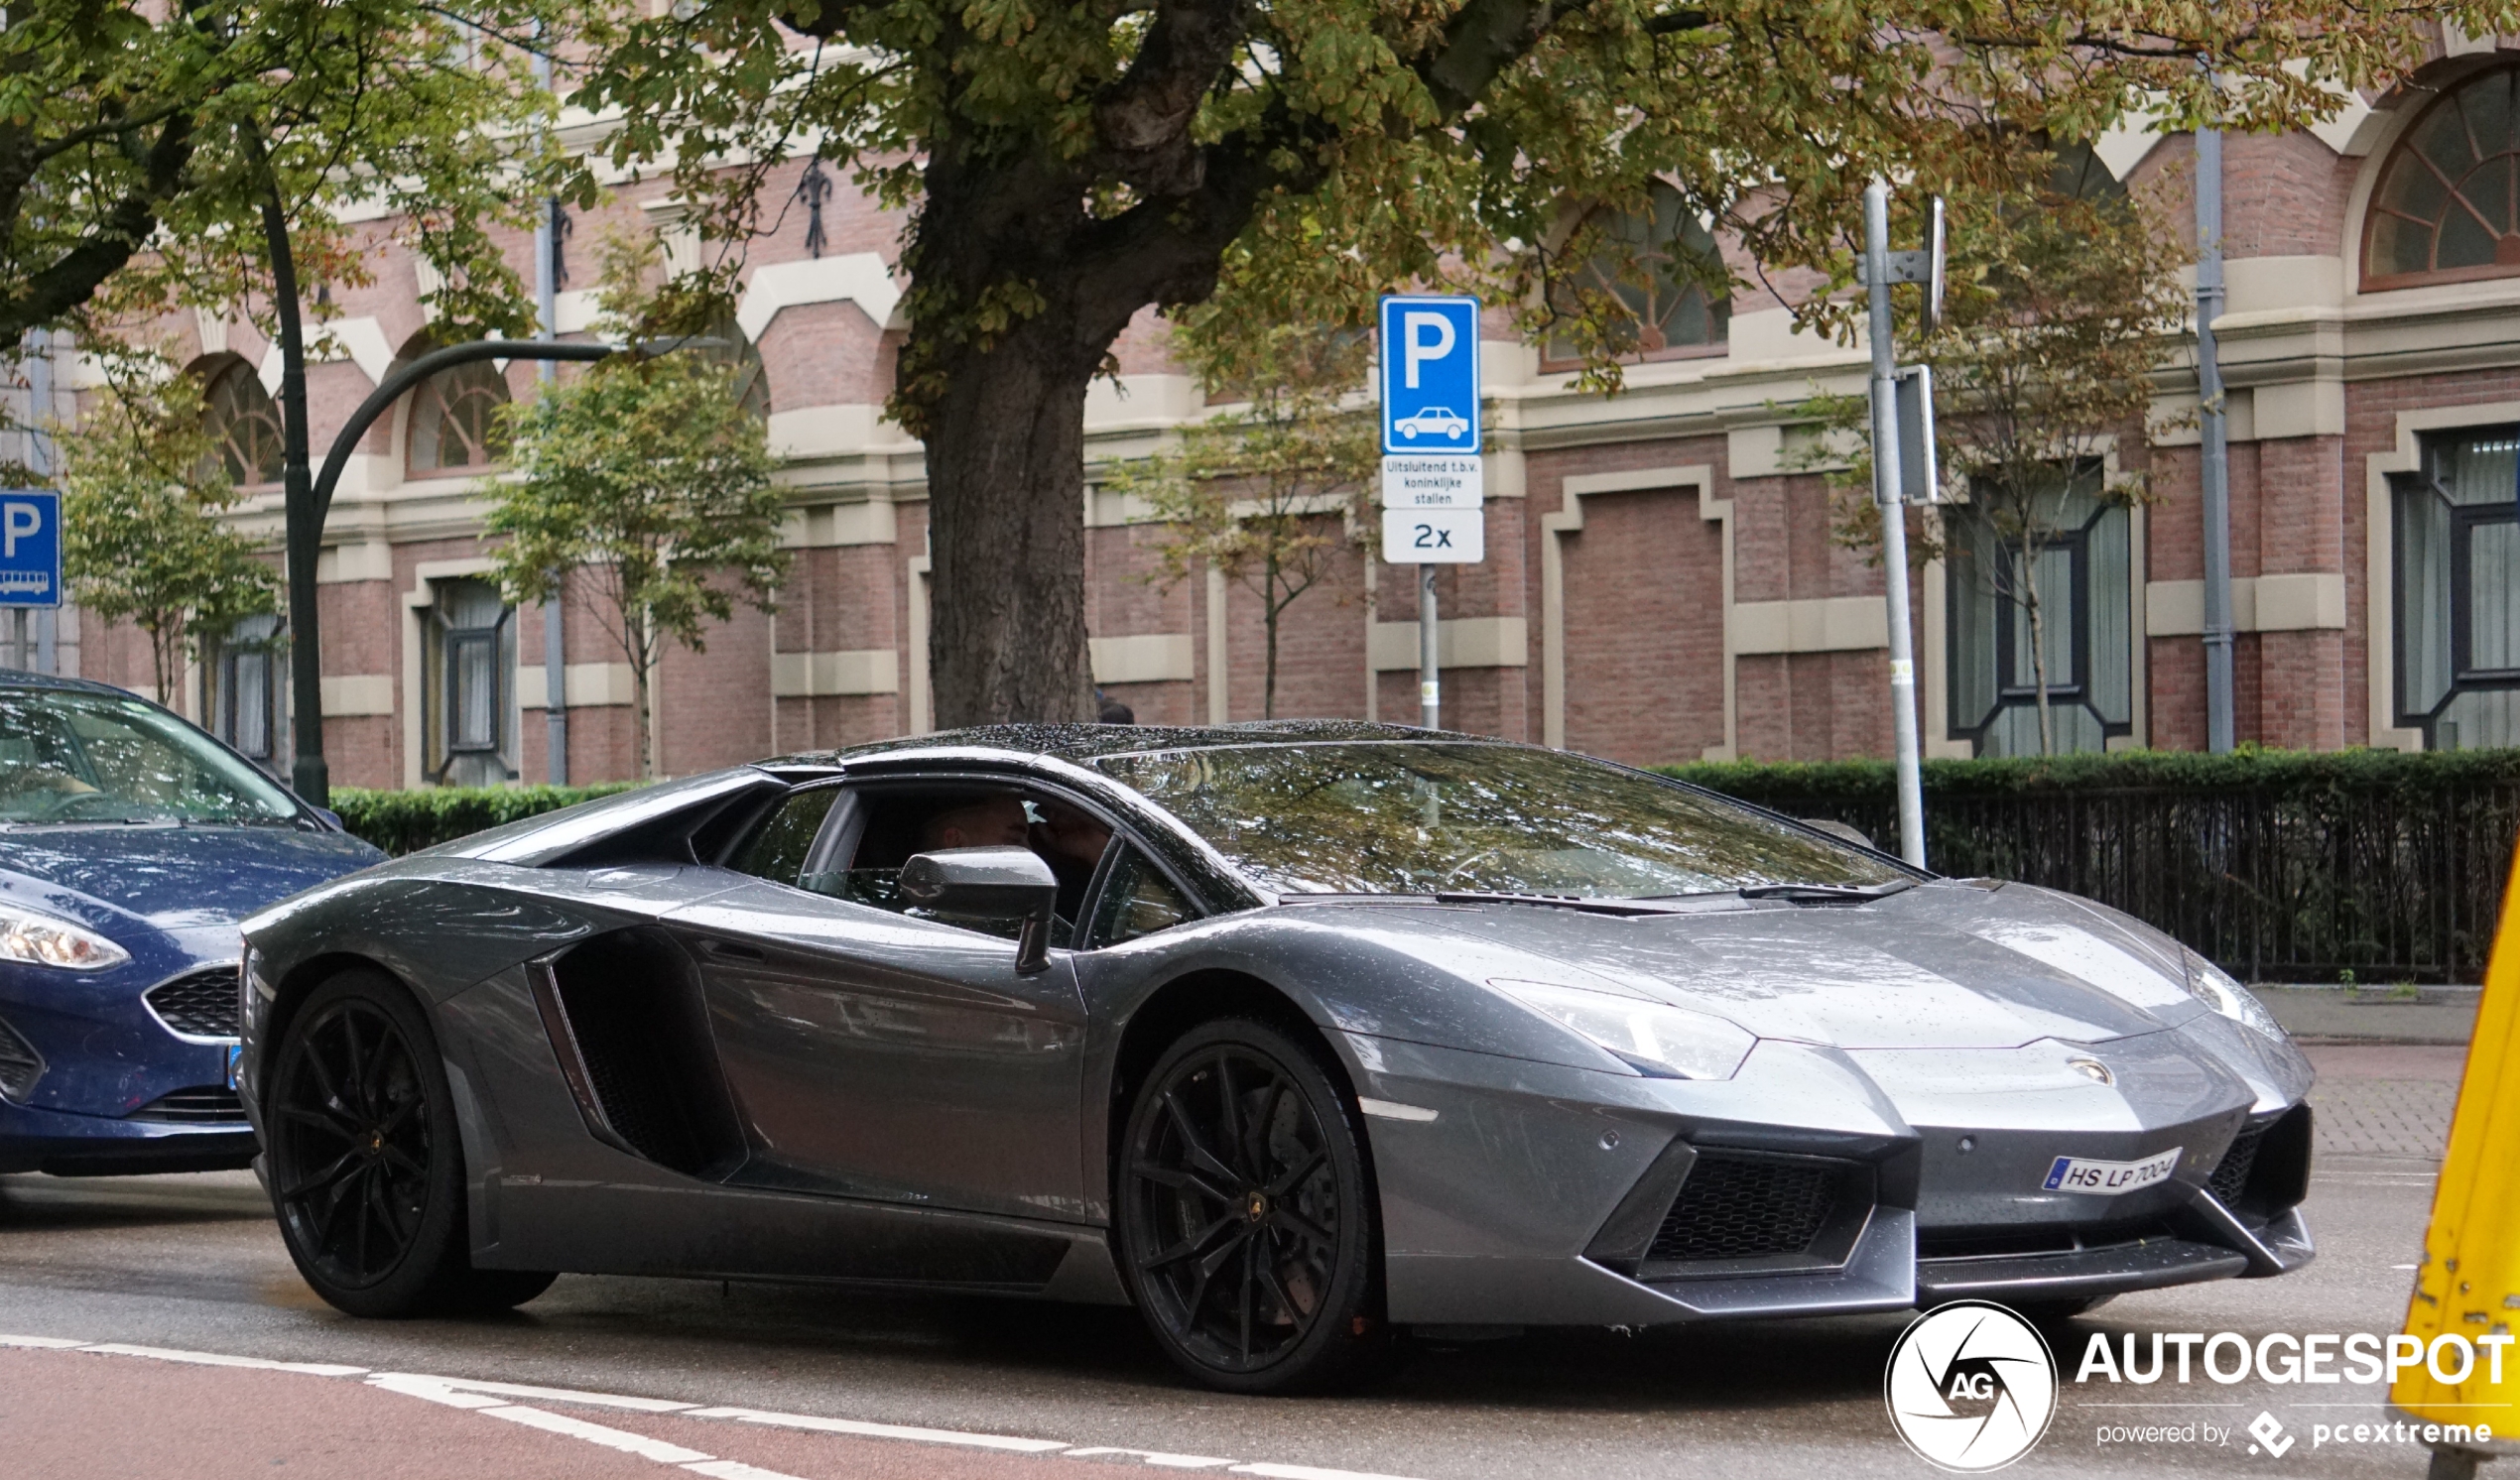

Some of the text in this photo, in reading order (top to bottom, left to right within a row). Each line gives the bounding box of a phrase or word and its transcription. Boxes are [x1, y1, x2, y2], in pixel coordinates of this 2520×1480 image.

[1405, 311, 1455, 388] P
[1387, 460, 1477, 472] Uitsluitend t.b.v.
[1404, 477, 1461, 491] koninklijke
[1415, 493, 1451, 504] stallen
[4, 502, 41, 557] P
[2067, 1157, 2174, 1187] HS LP 7004
